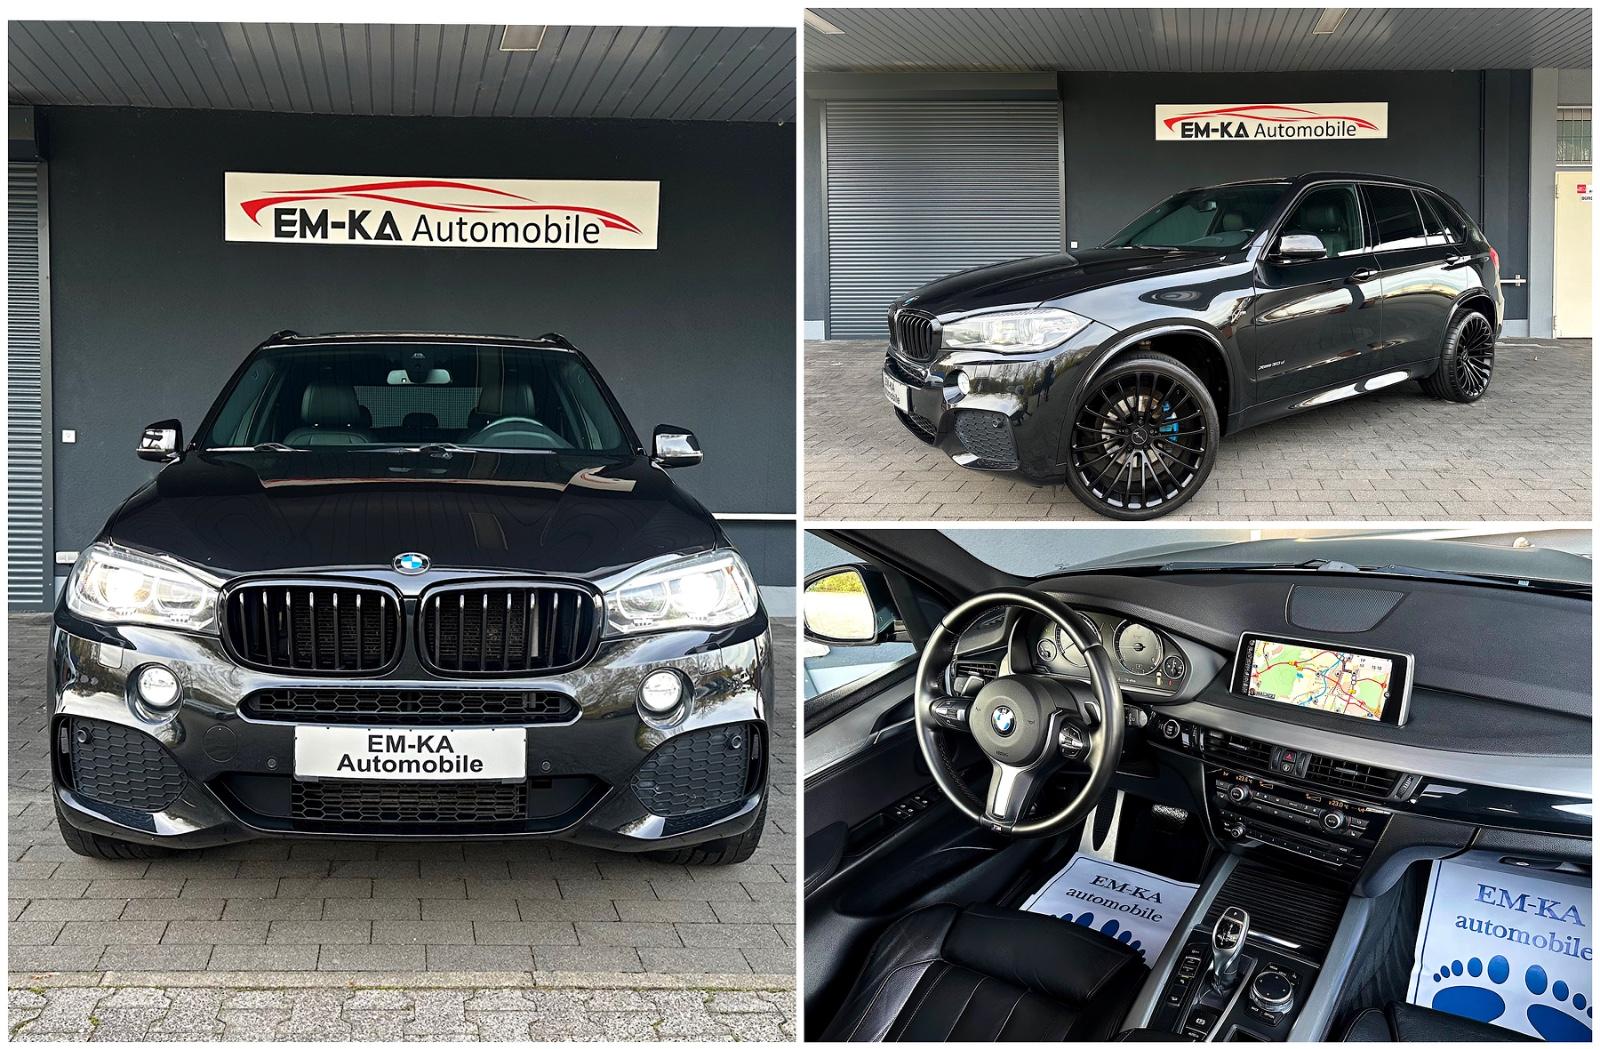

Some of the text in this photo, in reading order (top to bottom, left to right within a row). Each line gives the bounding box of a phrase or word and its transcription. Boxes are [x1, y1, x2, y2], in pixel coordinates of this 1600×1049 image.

[1181, 120, 1356, 139] EM-KA Automobile
[274, 207, 601, 244] EM-KA Automobile
[367, 734, 455, 753] EM-KA
[337, 753, 484, 773] Automobile
[1065, 888, 1163, 923] automobile
[1089, 875, 1163, 904] EM-KA
[1474, 883, 1586, 927] EM-KA
[1455, 915, 1592, 961] automobile
